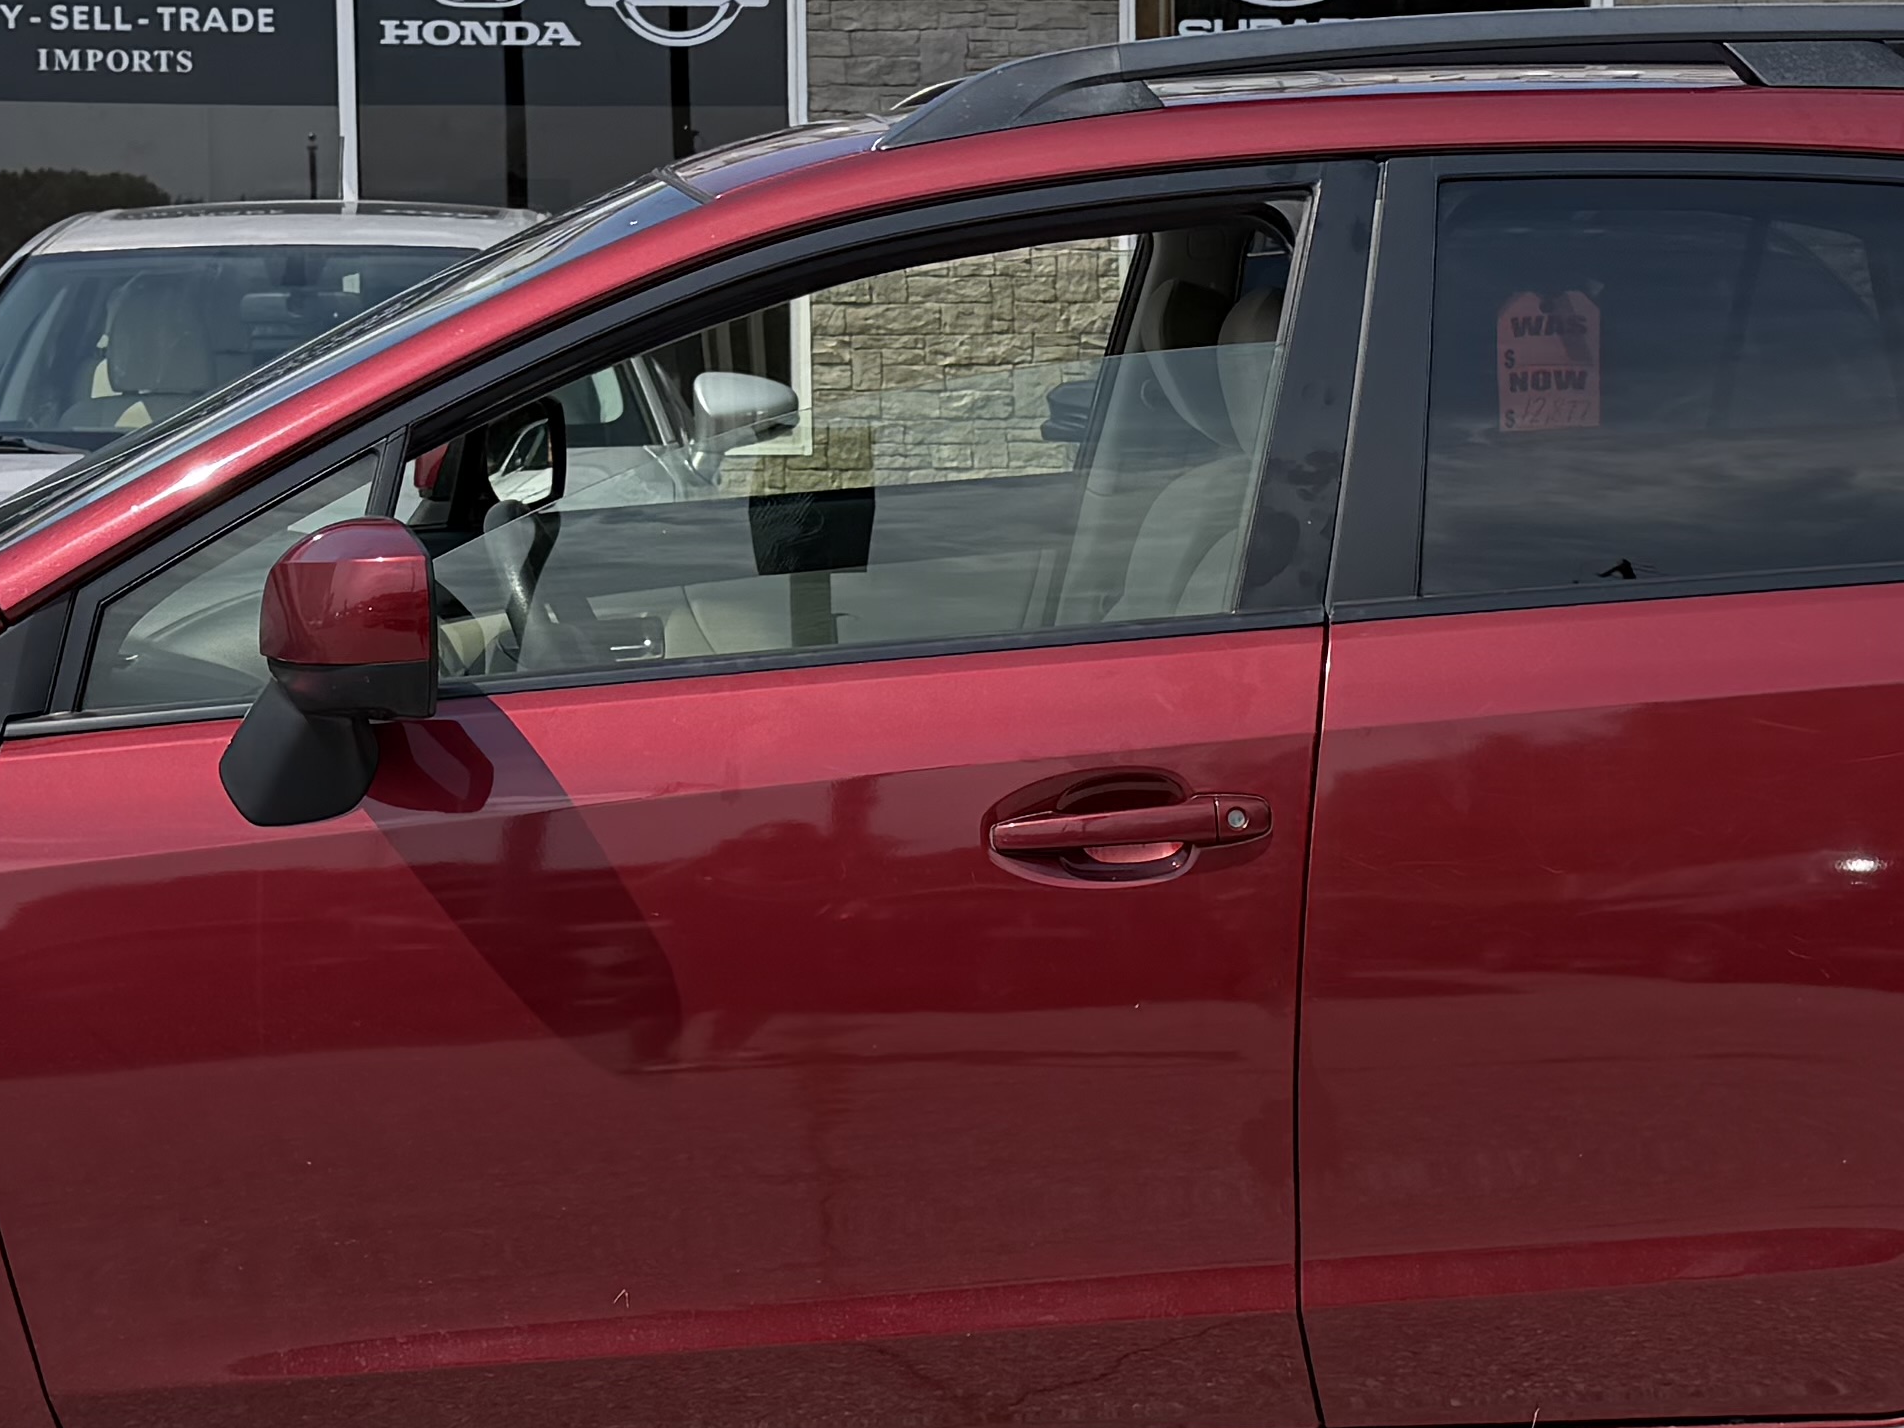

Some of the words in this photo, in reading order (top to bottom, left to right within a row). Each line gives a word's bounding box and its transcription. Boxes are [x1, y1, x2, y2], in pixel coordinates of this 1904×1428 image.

[380, 20, 582, 47] HONDA
[37, 49, 193, 73] IMPORTS
[1509, 315, 1588, 340] WAS
[1509, 370, 1588, 393] NOW
